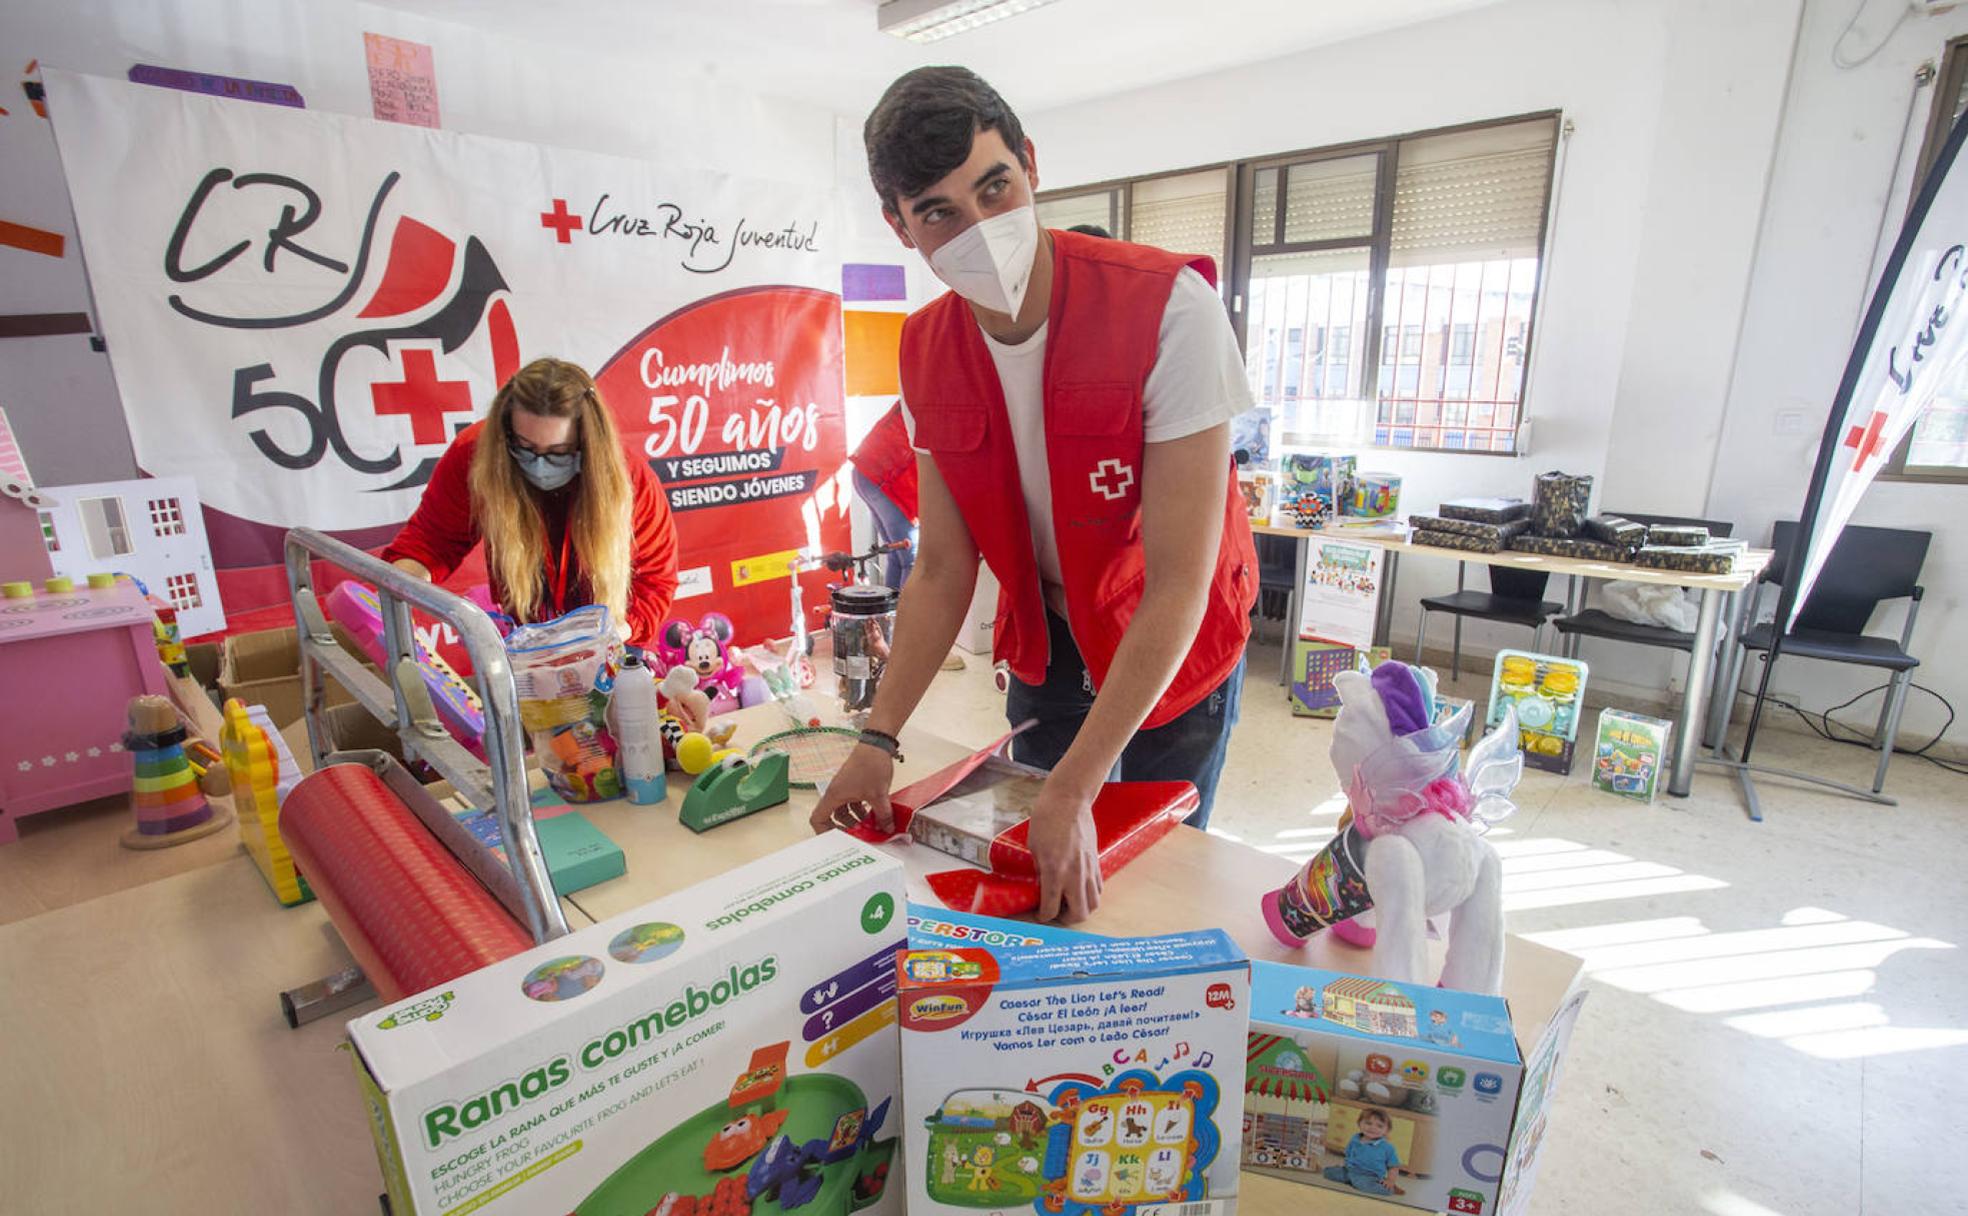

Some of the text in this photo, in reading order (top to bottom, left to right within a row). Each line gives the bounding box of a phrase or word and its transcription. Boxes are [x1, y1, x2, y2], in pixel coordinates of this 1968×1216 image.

[589, 194, 819, 273] Cruz Roja Juventud
[165, 168, 400, 329] CRJ
[640, 345, 775, 398] Cumplimos
[644, 395, 822, 457] 50 años
[667, 453, 772, 478] Y SEGUIMOS
[671, 475, 805, 508] SIENDO JÓVENES
[816, 855, 876, 882] Ranas
[705, 881, 815, 931] comebolas
[916, 1001, 963, 1014] WinFun
[999, 986, 1165, 1010] Caesar The Lion Let's Read!
[960, 1010, 1201, 1042] Игрушка «Лев Цезарь, давай почитаем!»
[1018, 1002, 1148, 1023] César El León ¡A leer!
[424, 1058, 570, 1147] Ranas
[581, 957, 776, 1068] comebolas
[993, 1026, 1170, 1052] Vamos Ler com o Leão César!
[1102, 1048, 1148, 1076] B C A
[431, 1144, 487, 1180] ESCOGE
[489, 1134, 507, 1149] LA
[509, 1114, 547, 1139] RANA
[549, 1097, 576, 1117] QUE
[579, 1082, 606, 1103] MÁS
[608, 1074, 622, 1088] TE
[623, 1053, 660, 1079] GUSTE
[660, 1048, 669, 1060] Y
[685, 1020, 727, 1047] COMER!
[1088, 1103, 1109, 1115] Gg
[1126, 1104, 1147, 1115] Hh
[1167, 1100, 1181, 1111] Ii
[437, 1175, 494, 1209] CHOOSE
[497, 1151, 532, 1176] YOUR
[534, 1117, 595, 1157] FAVOURITE
[597, 1100, 627, 1121] FROG
[629, 1085, 654, 1104] AND
[681, 1060, 699, 1077] EAT
[433, 1156, 493, 1195] HUNGRY
[495, 1137, 530, 1162] FROG
[1085, 1153, 1100, 1166] Jj
[1118, 1154, 1140, 1165] Kk
[1158, 1151, 1171, 1162] Ll
